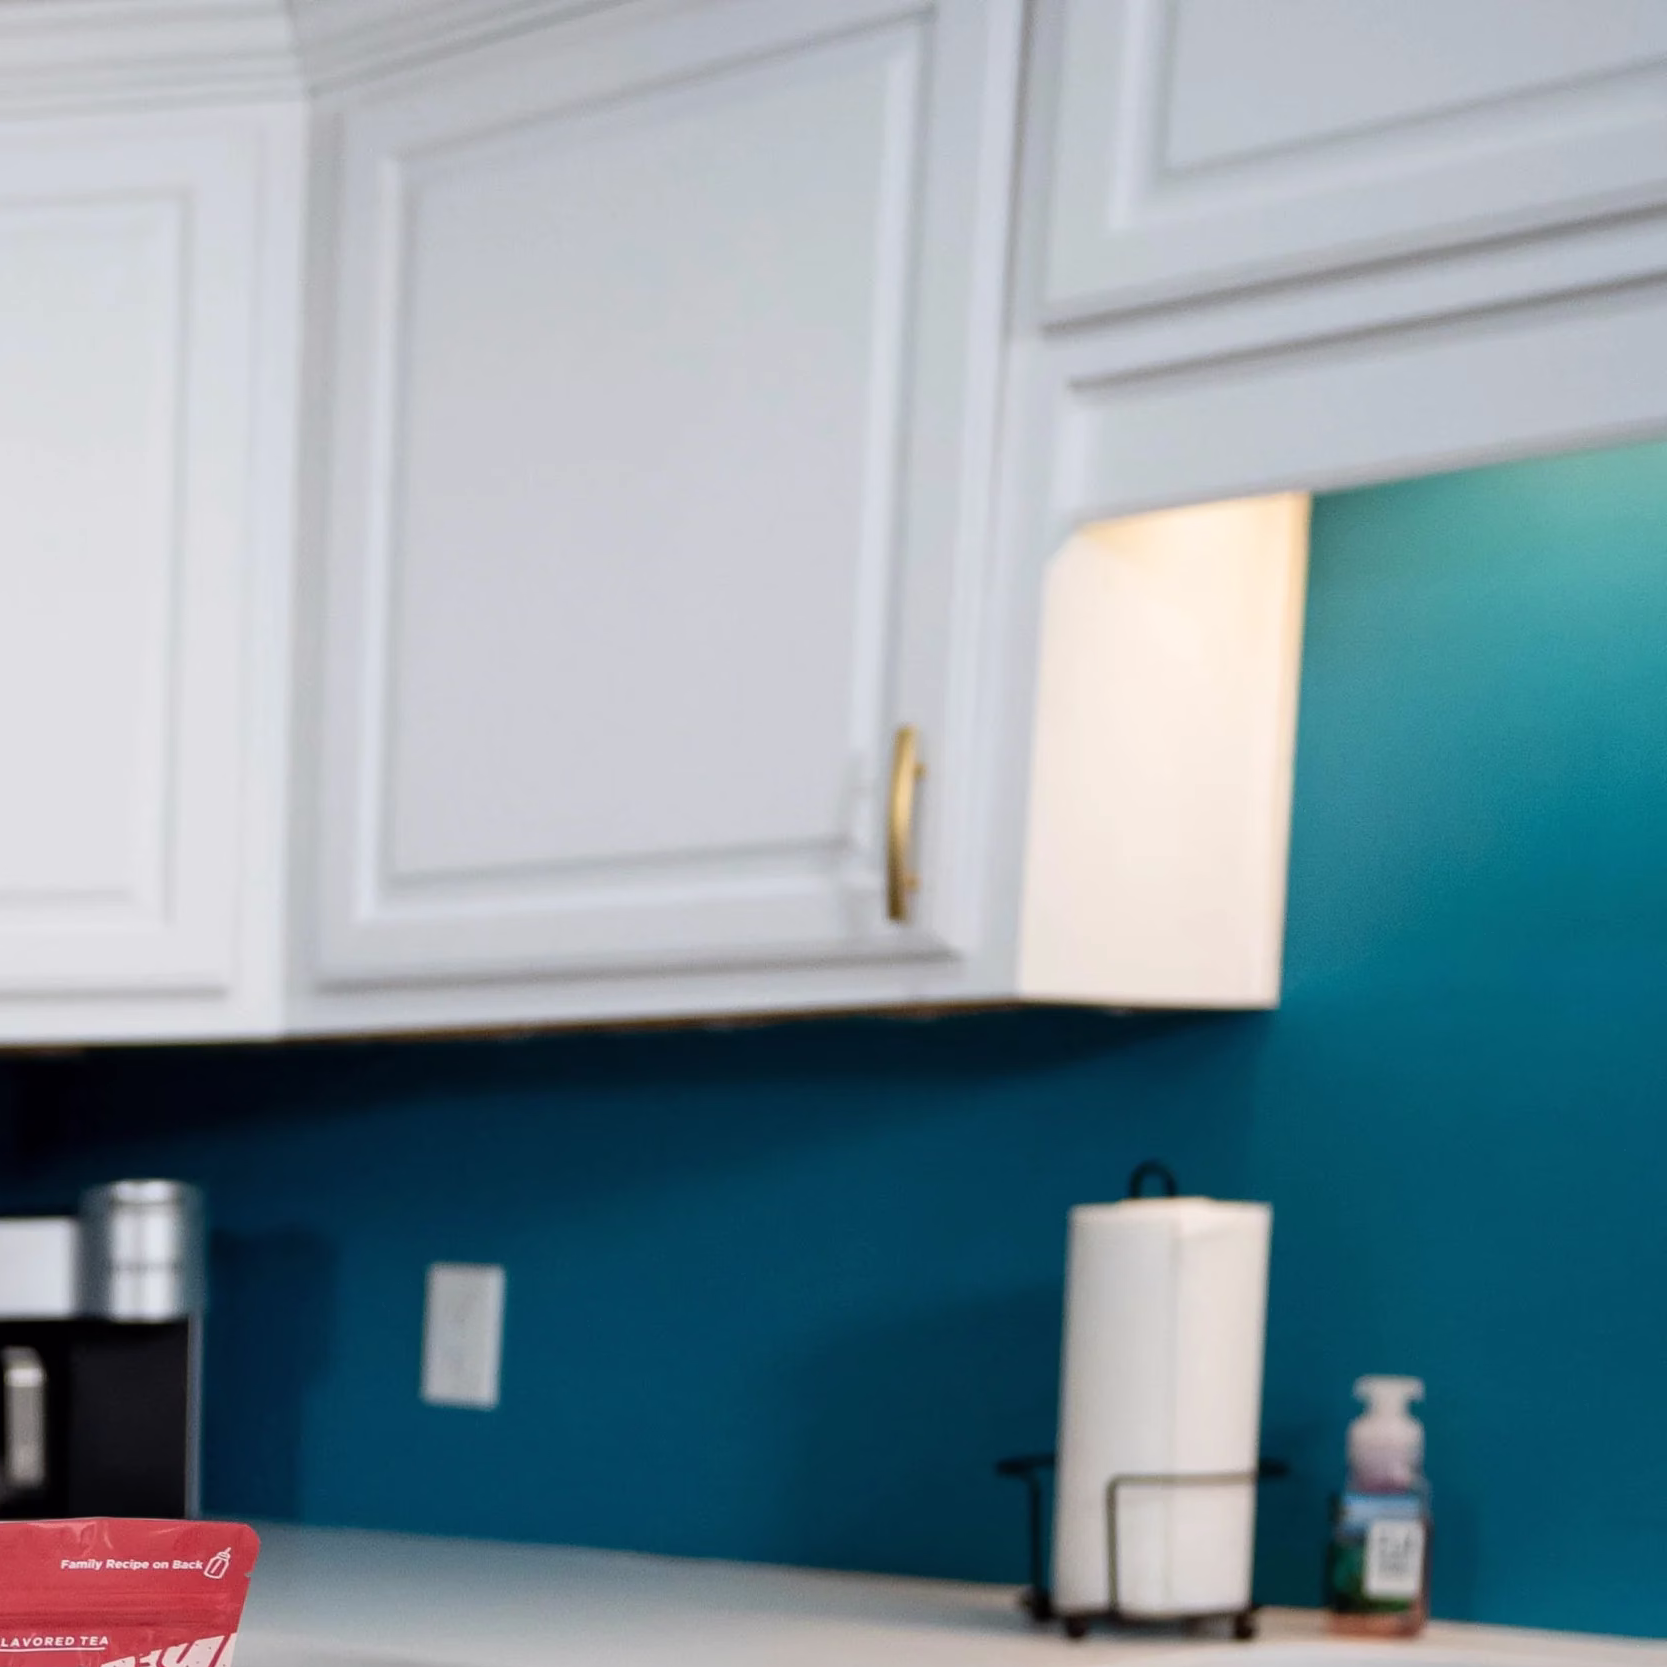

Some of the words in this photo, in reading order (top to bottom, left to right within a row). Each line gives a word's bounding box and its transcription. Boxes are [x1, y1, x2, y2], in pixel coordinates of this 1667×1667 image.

[61, 1559, 103, 1571] Family
[105, 1559, 149, 1571] Recipe
[152, 1561, 169, 1569] on
[171, 1559, 203, 1570] Back
[80, 1635, 109, 1647] TEA
